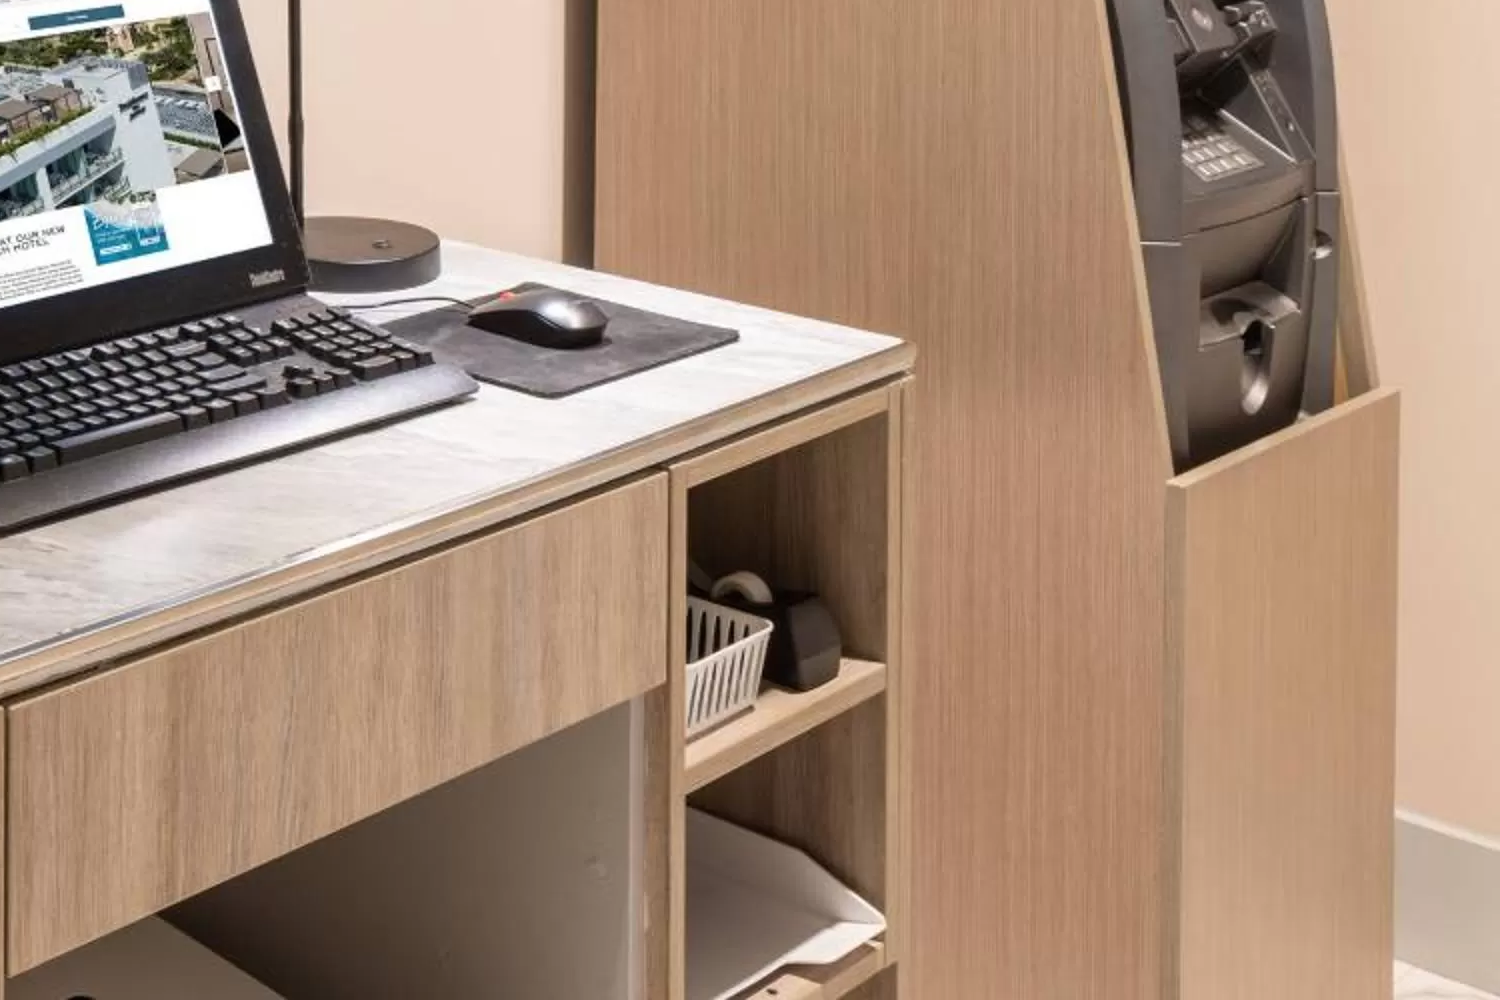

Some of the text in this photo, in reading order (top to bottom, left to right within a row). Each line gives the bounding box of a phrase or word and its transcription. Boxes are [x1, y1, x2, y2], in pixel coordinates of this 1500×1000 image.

[0, 236, 12, 246] AT
[15, 230, 39, 243] OUR
[41, 225, 66, 238] NEW
[13, 239, 51, 253] HOTEL
